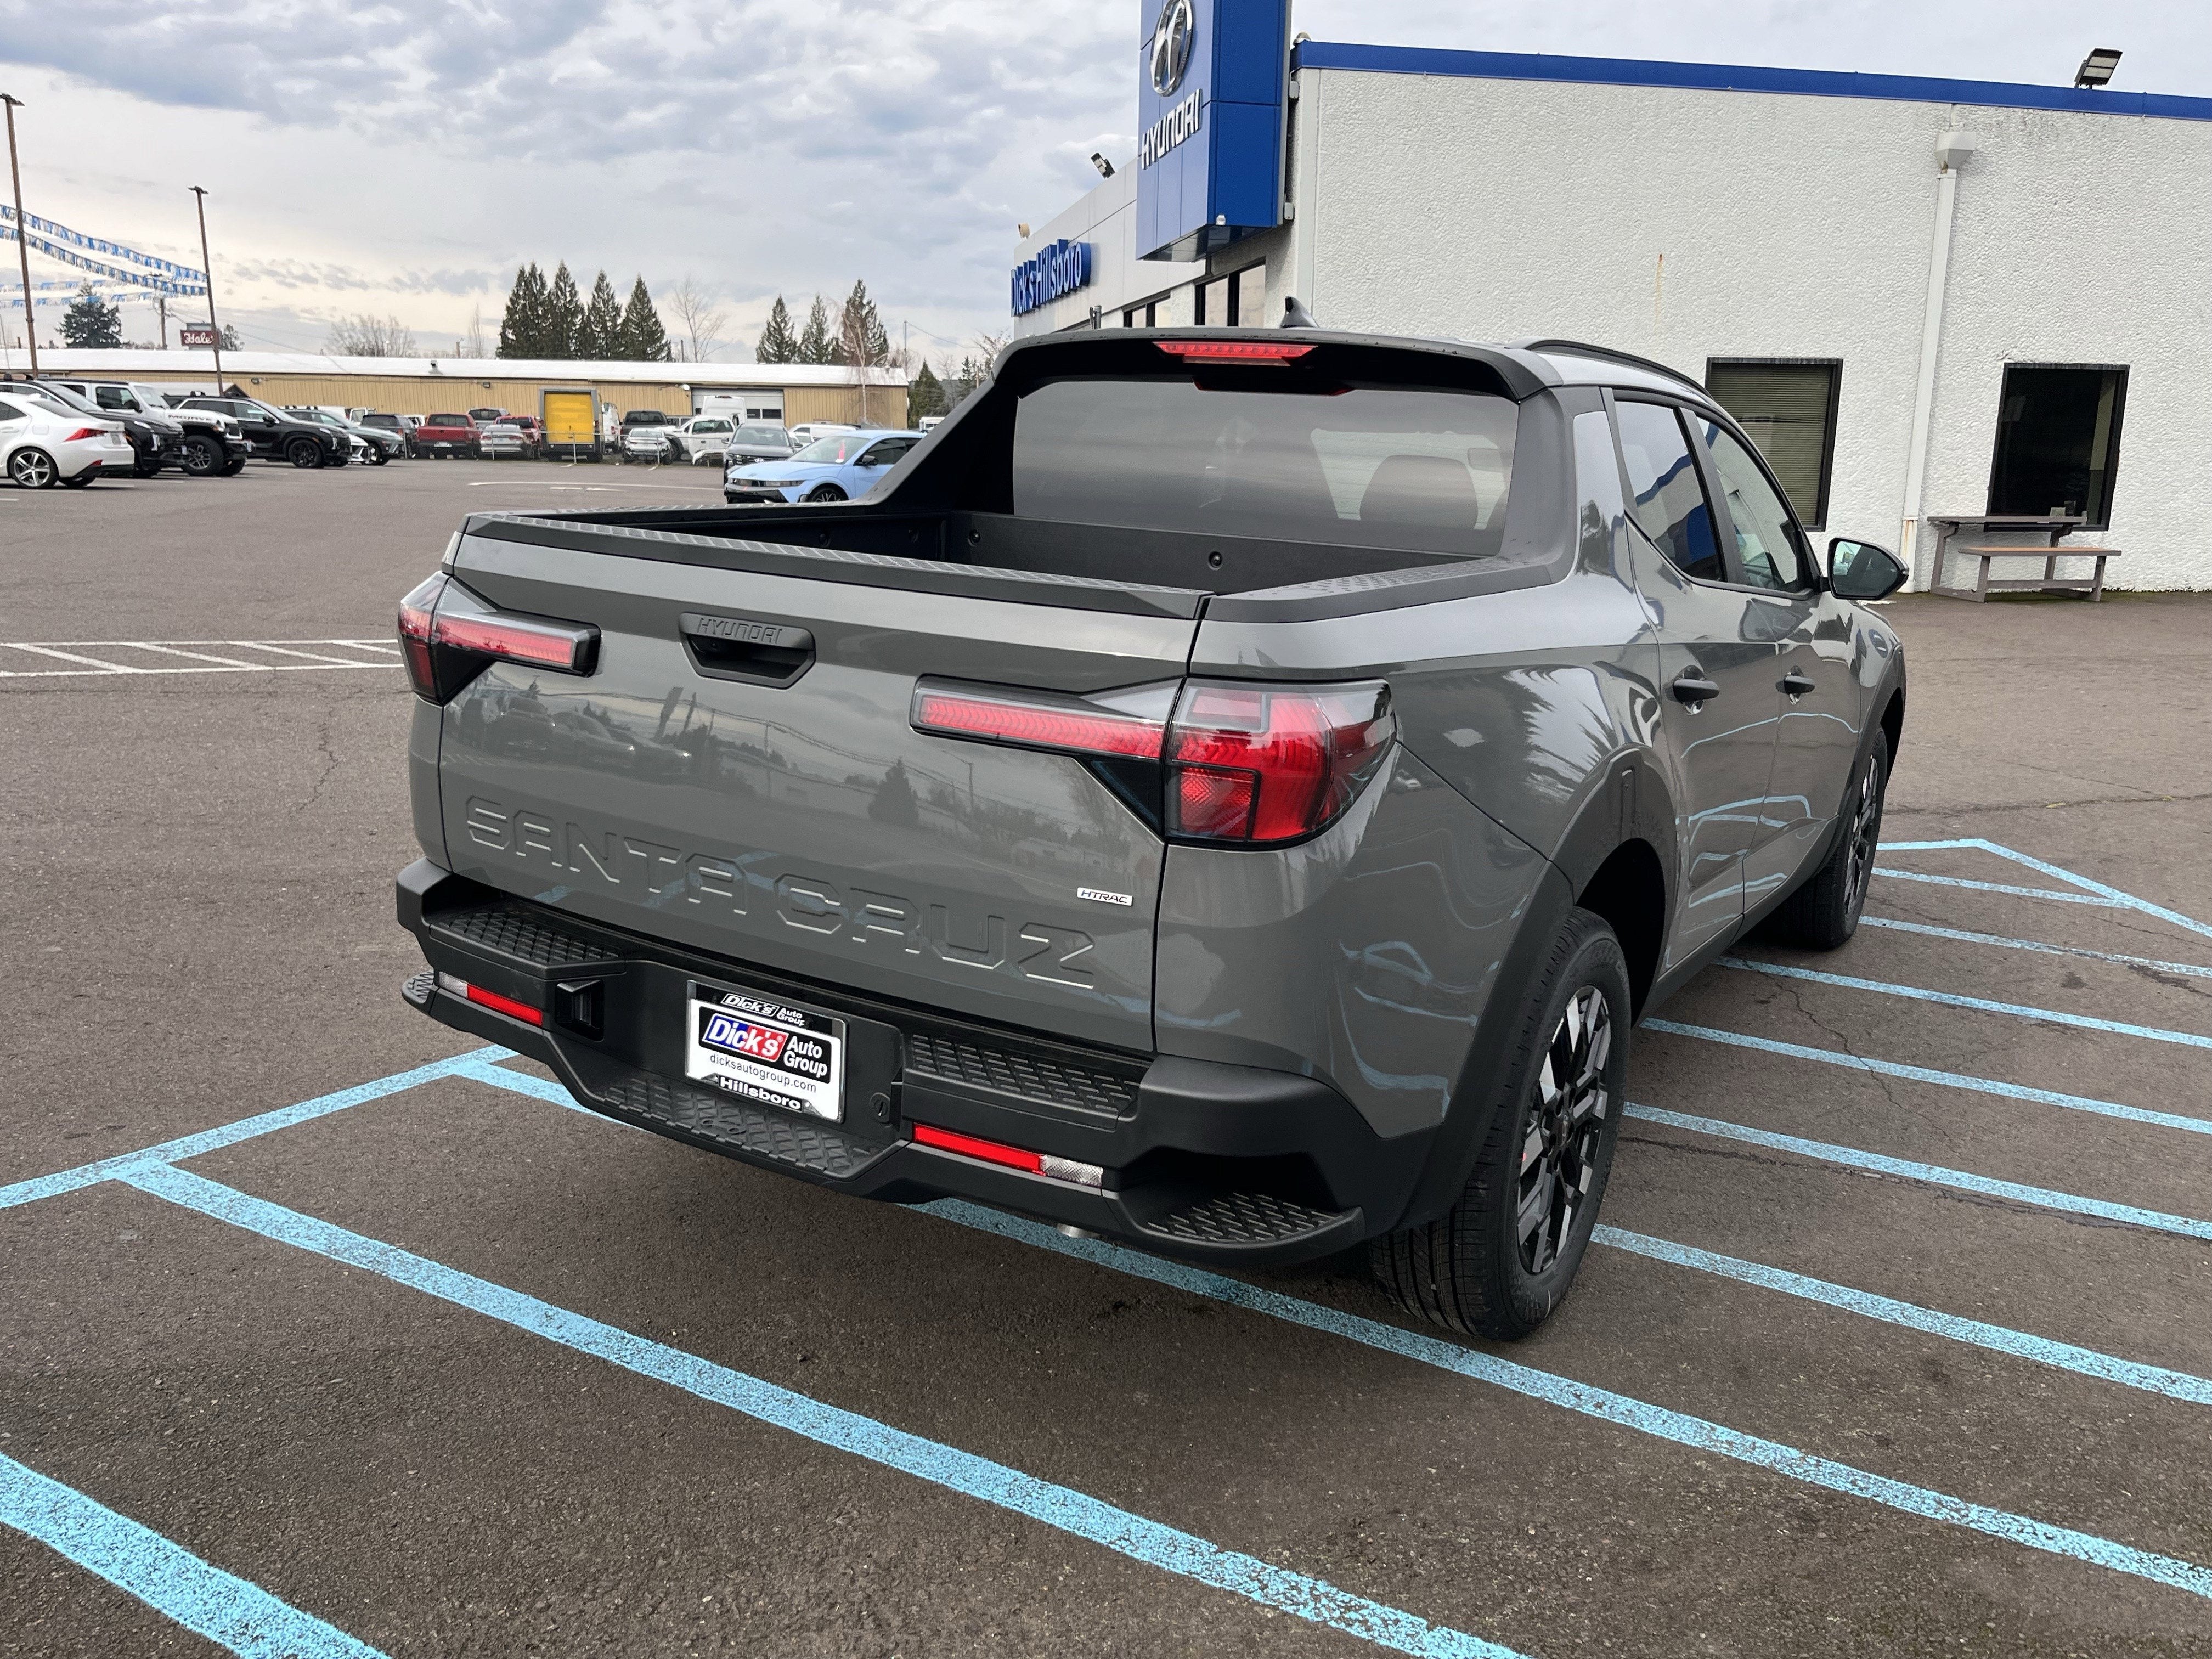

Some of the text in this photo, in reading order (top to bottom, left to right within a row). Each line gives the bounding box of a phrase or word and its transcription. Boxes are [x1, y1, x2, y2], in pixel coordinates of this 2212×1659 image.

[1141, 88, 1203, 170] HYUNDAI
[1036, 239, 1087, 306] Hillsboro
[697, 618, 782, 644] HYUNDAI
[466, 795, 1094, 990] SANTA CRUZ
[1081, 890, 1128, 904] HTRAC
[725, 995, 803, 1019] Dick's Auto
[708, 1018, 822, 1058] Dick's Auto
[710, 1053, 816, 1093] dicksautogroup.com
[783, 1051, 827, 1078] Group
[719, 1076, 801, 1109] Hillsboro
